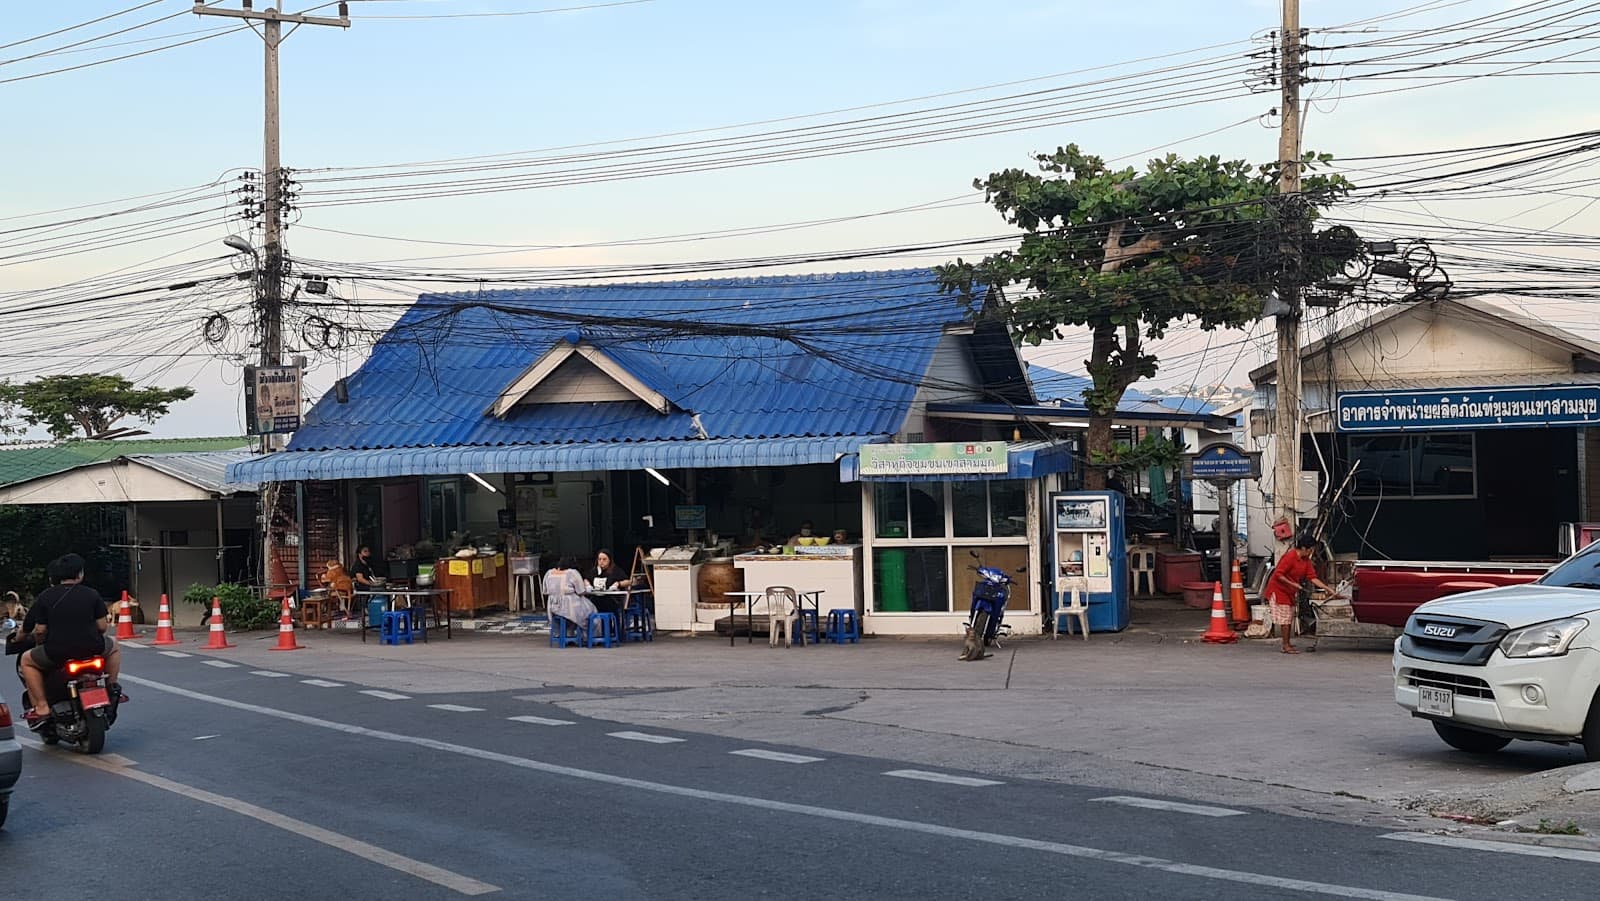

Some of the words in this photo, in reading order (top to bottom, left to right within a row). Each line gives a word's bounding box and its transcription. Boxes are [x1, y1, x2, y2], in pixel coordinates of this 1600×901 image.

[1342, 395, 1597, 424] อาคารจำหน่ายผลิตภัณฑ์ชุมชนเขาสามมุข
[1424, 624, 1456, 637] ISUZU
[1434, 691, 1450, 704] 5137
